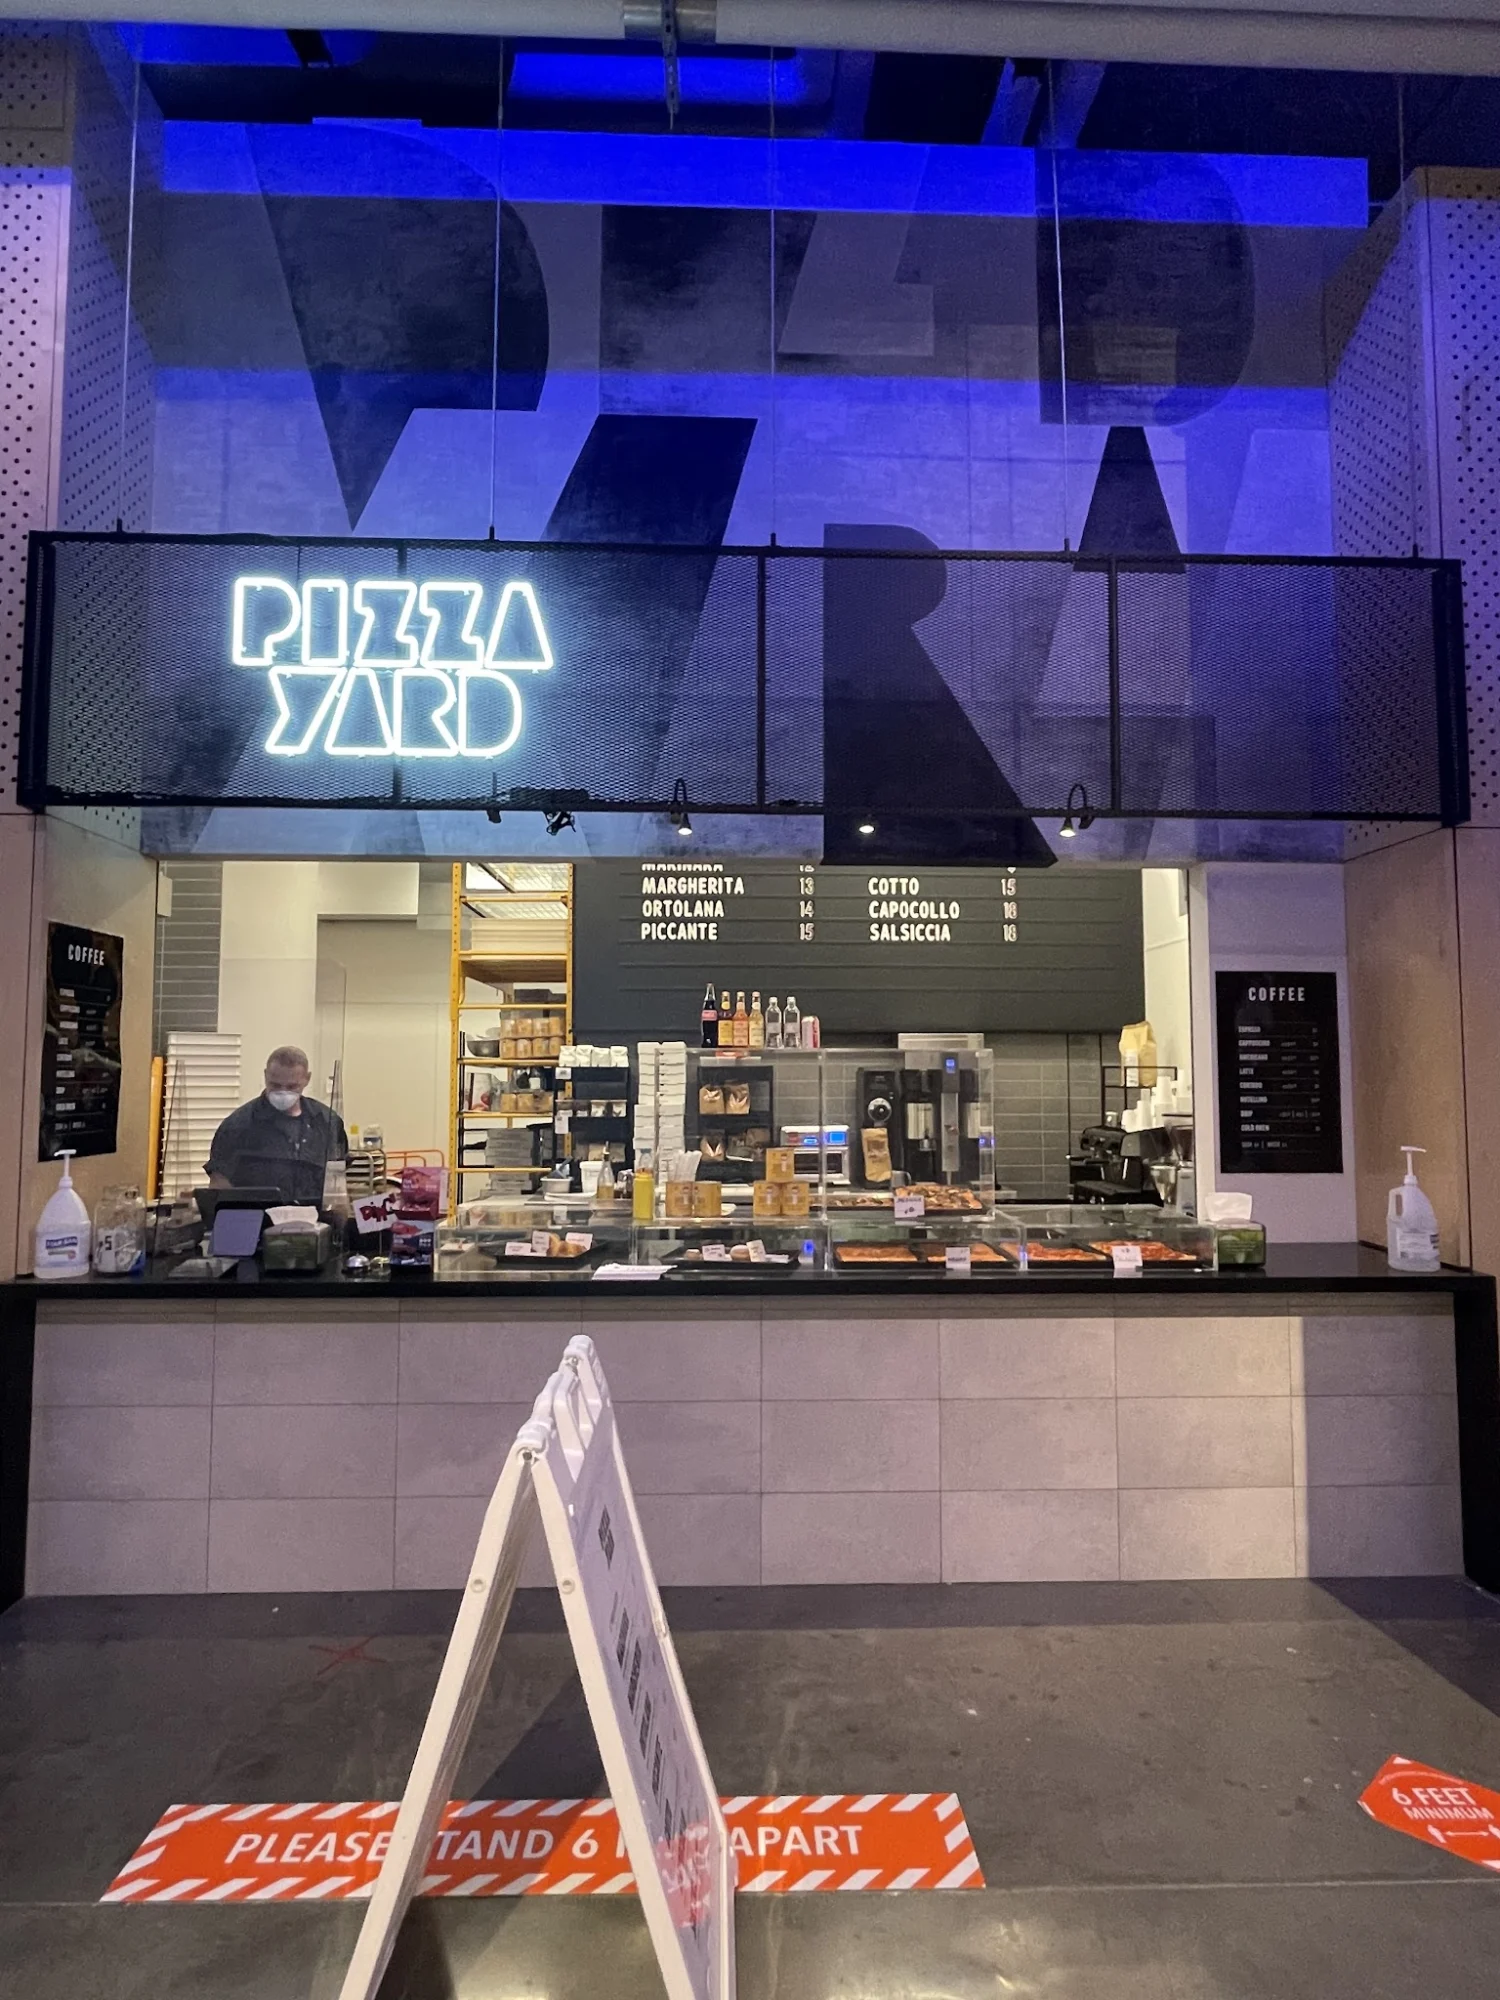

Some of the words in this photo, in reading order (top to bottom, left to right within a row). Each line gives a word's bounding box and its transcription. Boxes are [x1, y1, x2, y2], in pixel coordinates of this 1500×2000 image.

[232, 577, 554, 670] PIZZA
[265, 666, 523, 757] YARD
[642, 876, 745, 895] MARGHERITA
[799, 877, 815, 895] 13
[868, 877, 920, 896] COTTO
[1000, 878, 1017, 896] 15
[642, 899, 725, 918] ORTOLANA
[799, 900, 815, 918] 14
[868, 900, 960, 919] CAPOCOLLO
[640, 922, 718, 941] PICCANTE
[799, 922, 815, 941] 15
[869, 923, 951, 942] SALSICCIA
[67, 943, 105, 966] COFFEE
[1248, 986, 1306, 1002] COFFEE
[1391, 1787, 1413, 1806] 6
[1411, 1787, 1478, 1806] FEET
[1402, 1806, 1495, 1820] MINIMUM
[224, 1830, 394, 1865] PLEASE
[436, 1829, 554, 1861] TAND
[571, 1829, 599, 1858] 6
[728, 1825, 864, 1857] APART
